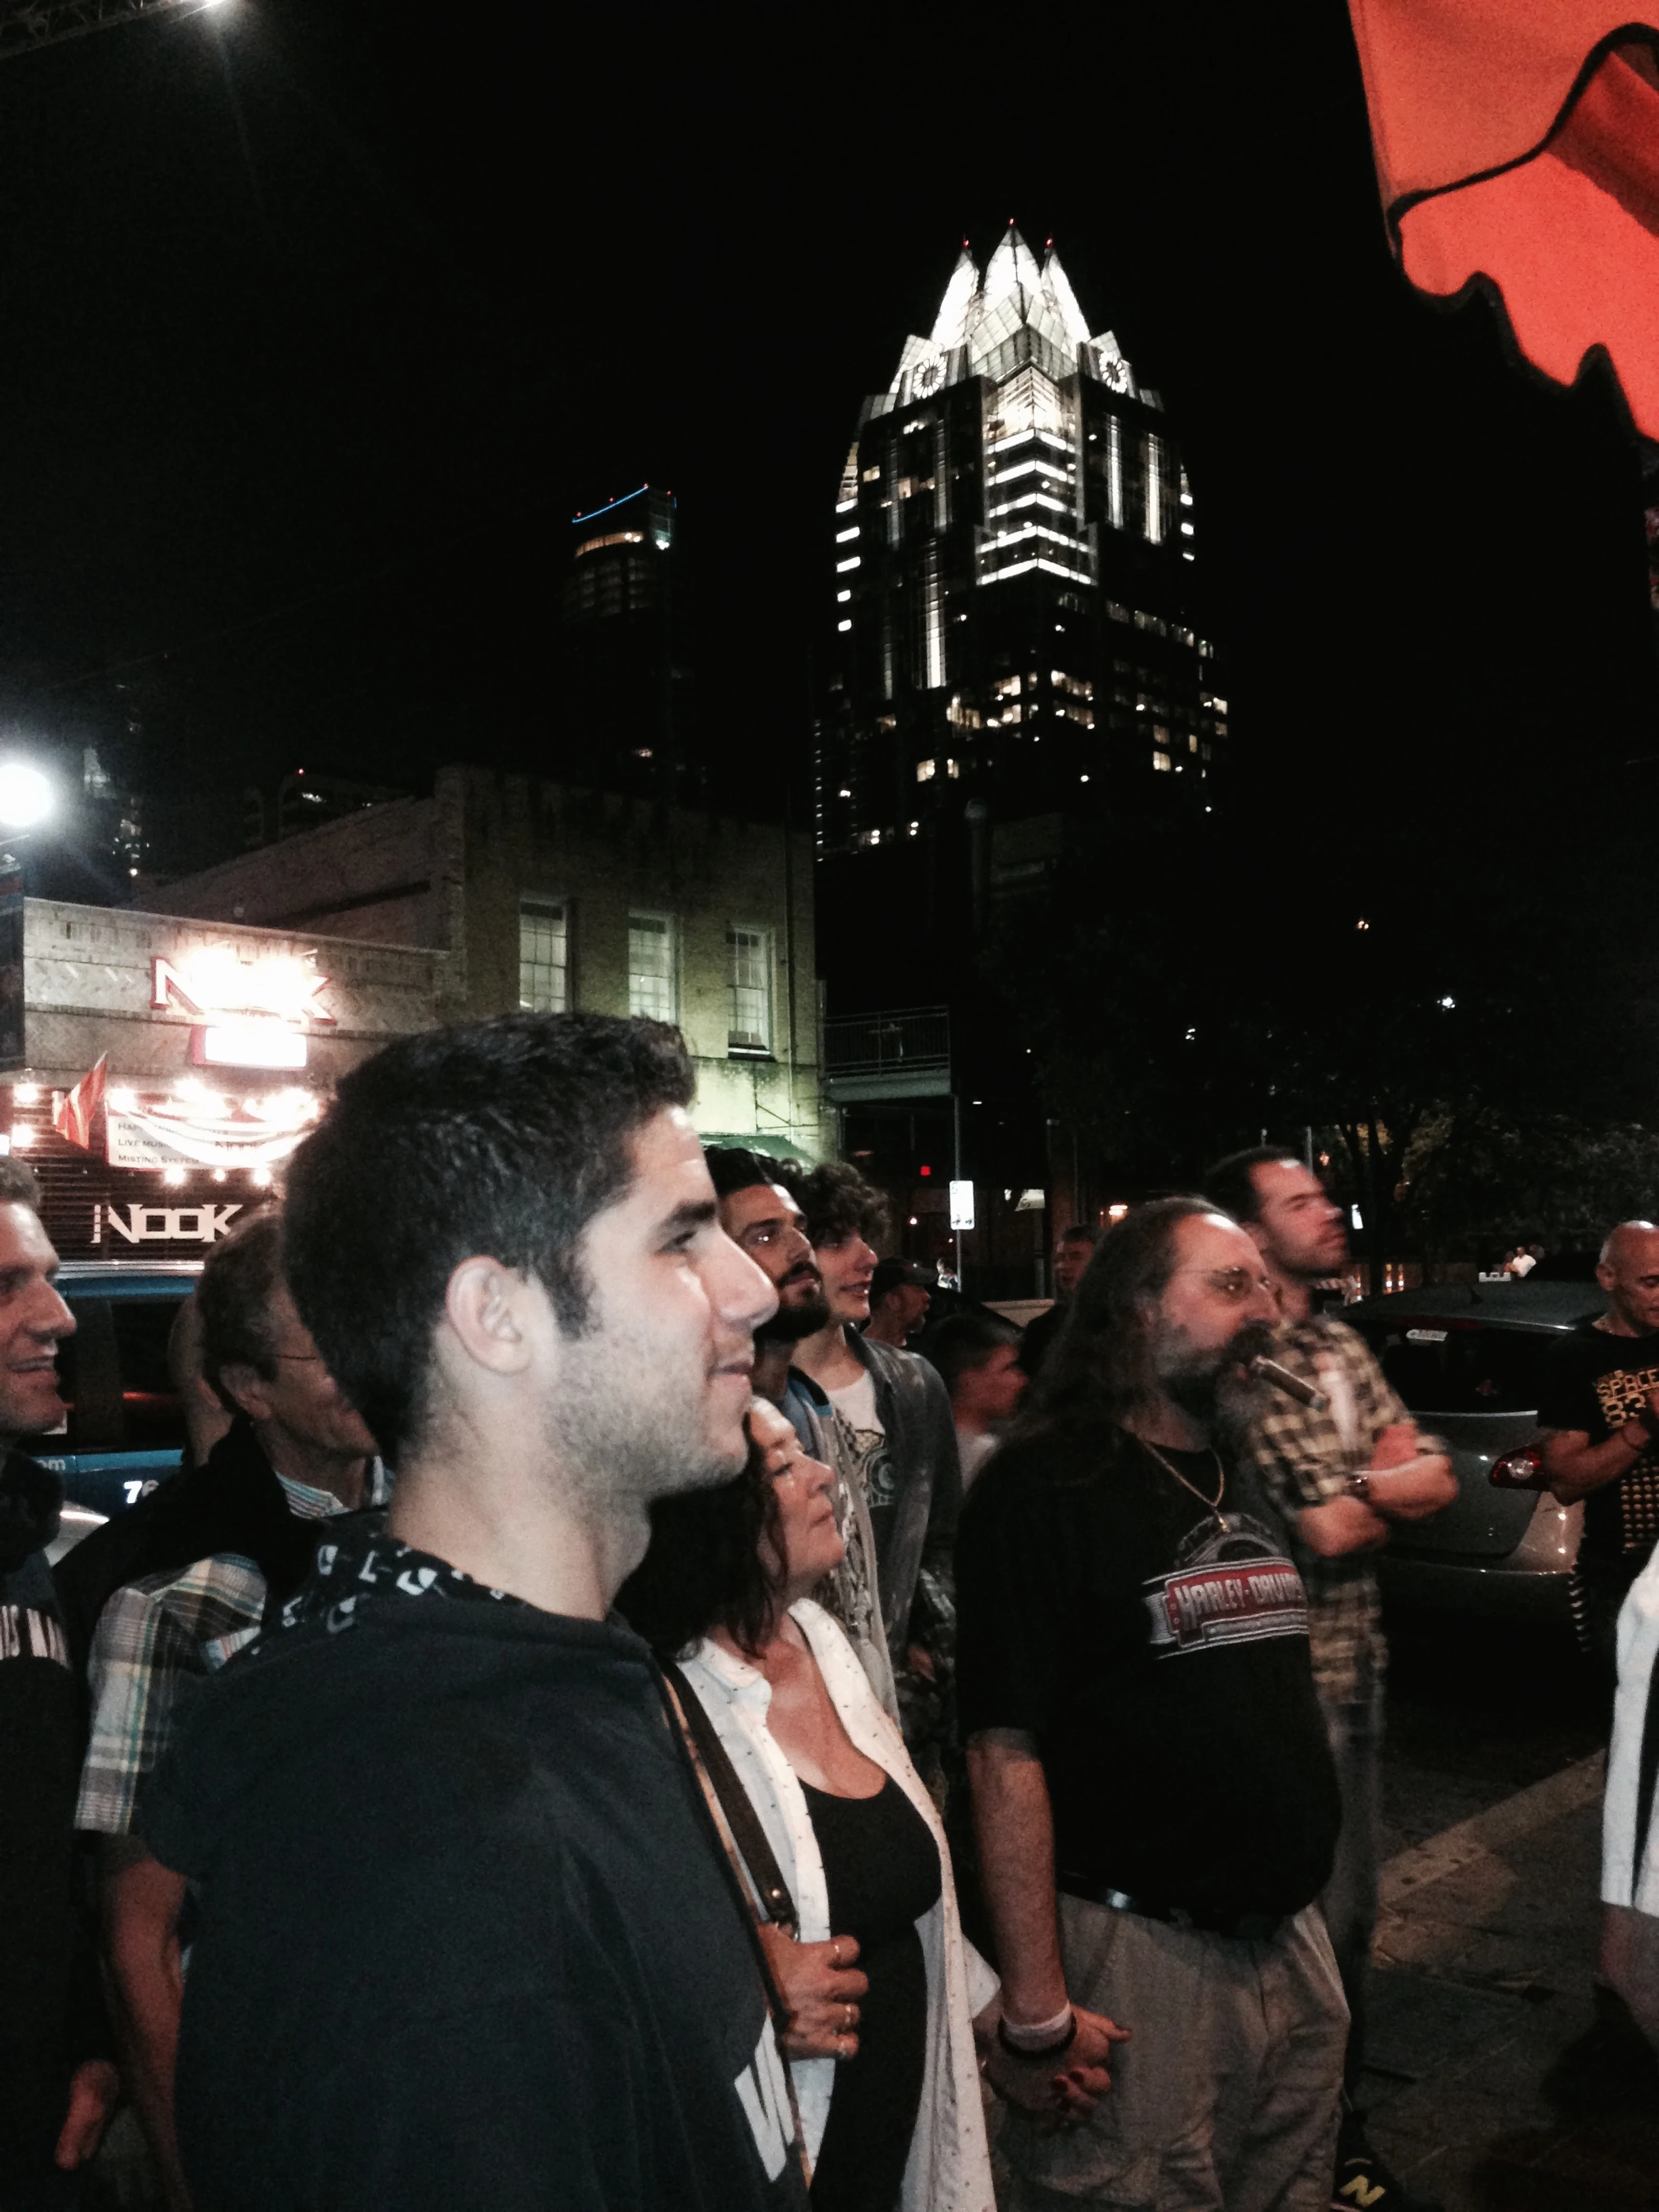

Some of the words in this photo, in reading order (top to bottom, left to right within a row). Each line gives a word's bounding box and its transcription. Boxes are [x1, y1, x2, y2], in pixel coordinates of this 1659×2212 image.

[148, 956, 334, 1025] NK
[142, 1140, 171, 1148] MUSI
[90, 1204, 243, 1244] NOOK
